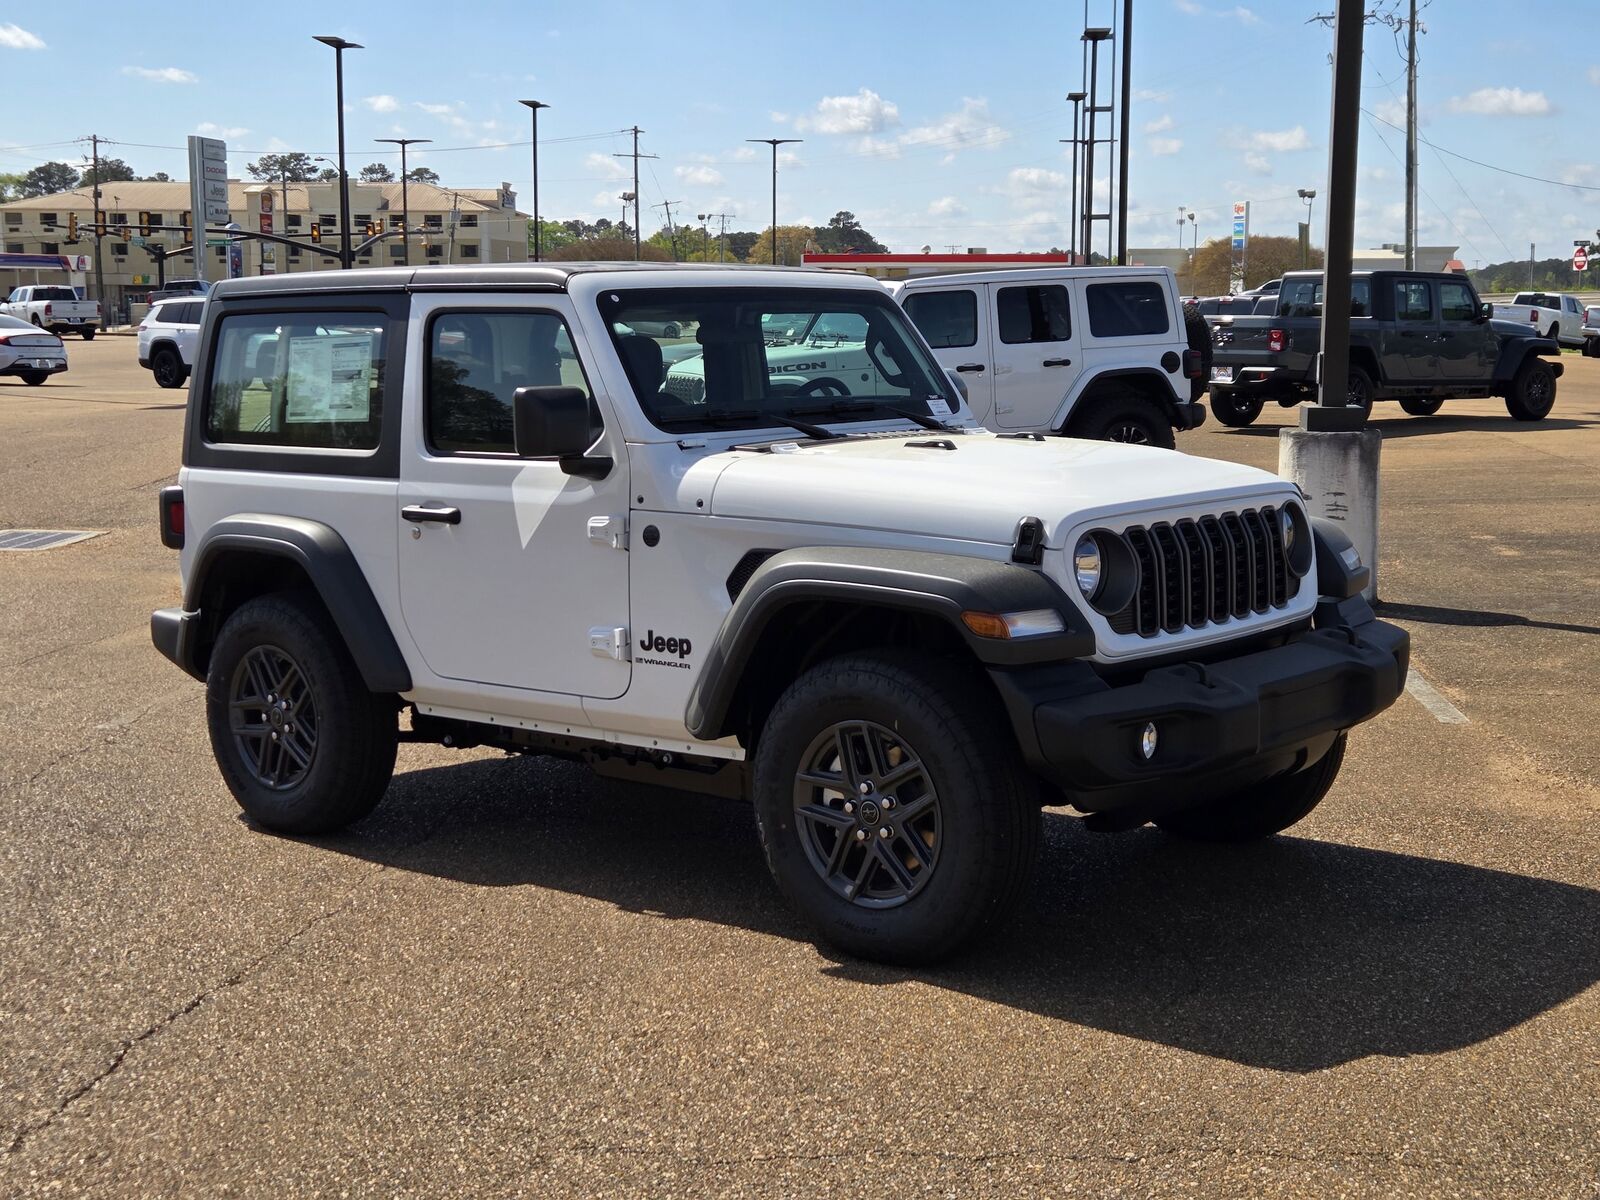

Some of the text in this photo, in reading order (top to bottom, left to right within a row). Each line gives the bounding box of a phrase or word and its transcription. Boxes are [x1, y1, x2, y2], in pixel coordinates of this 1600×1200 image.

[210, 184, 225, 198] Jeep
[768, 361, 827, 374] BICON
[640, 629, 692, 659] Jeep
[643, 657, 691, 670] WRANGLER
